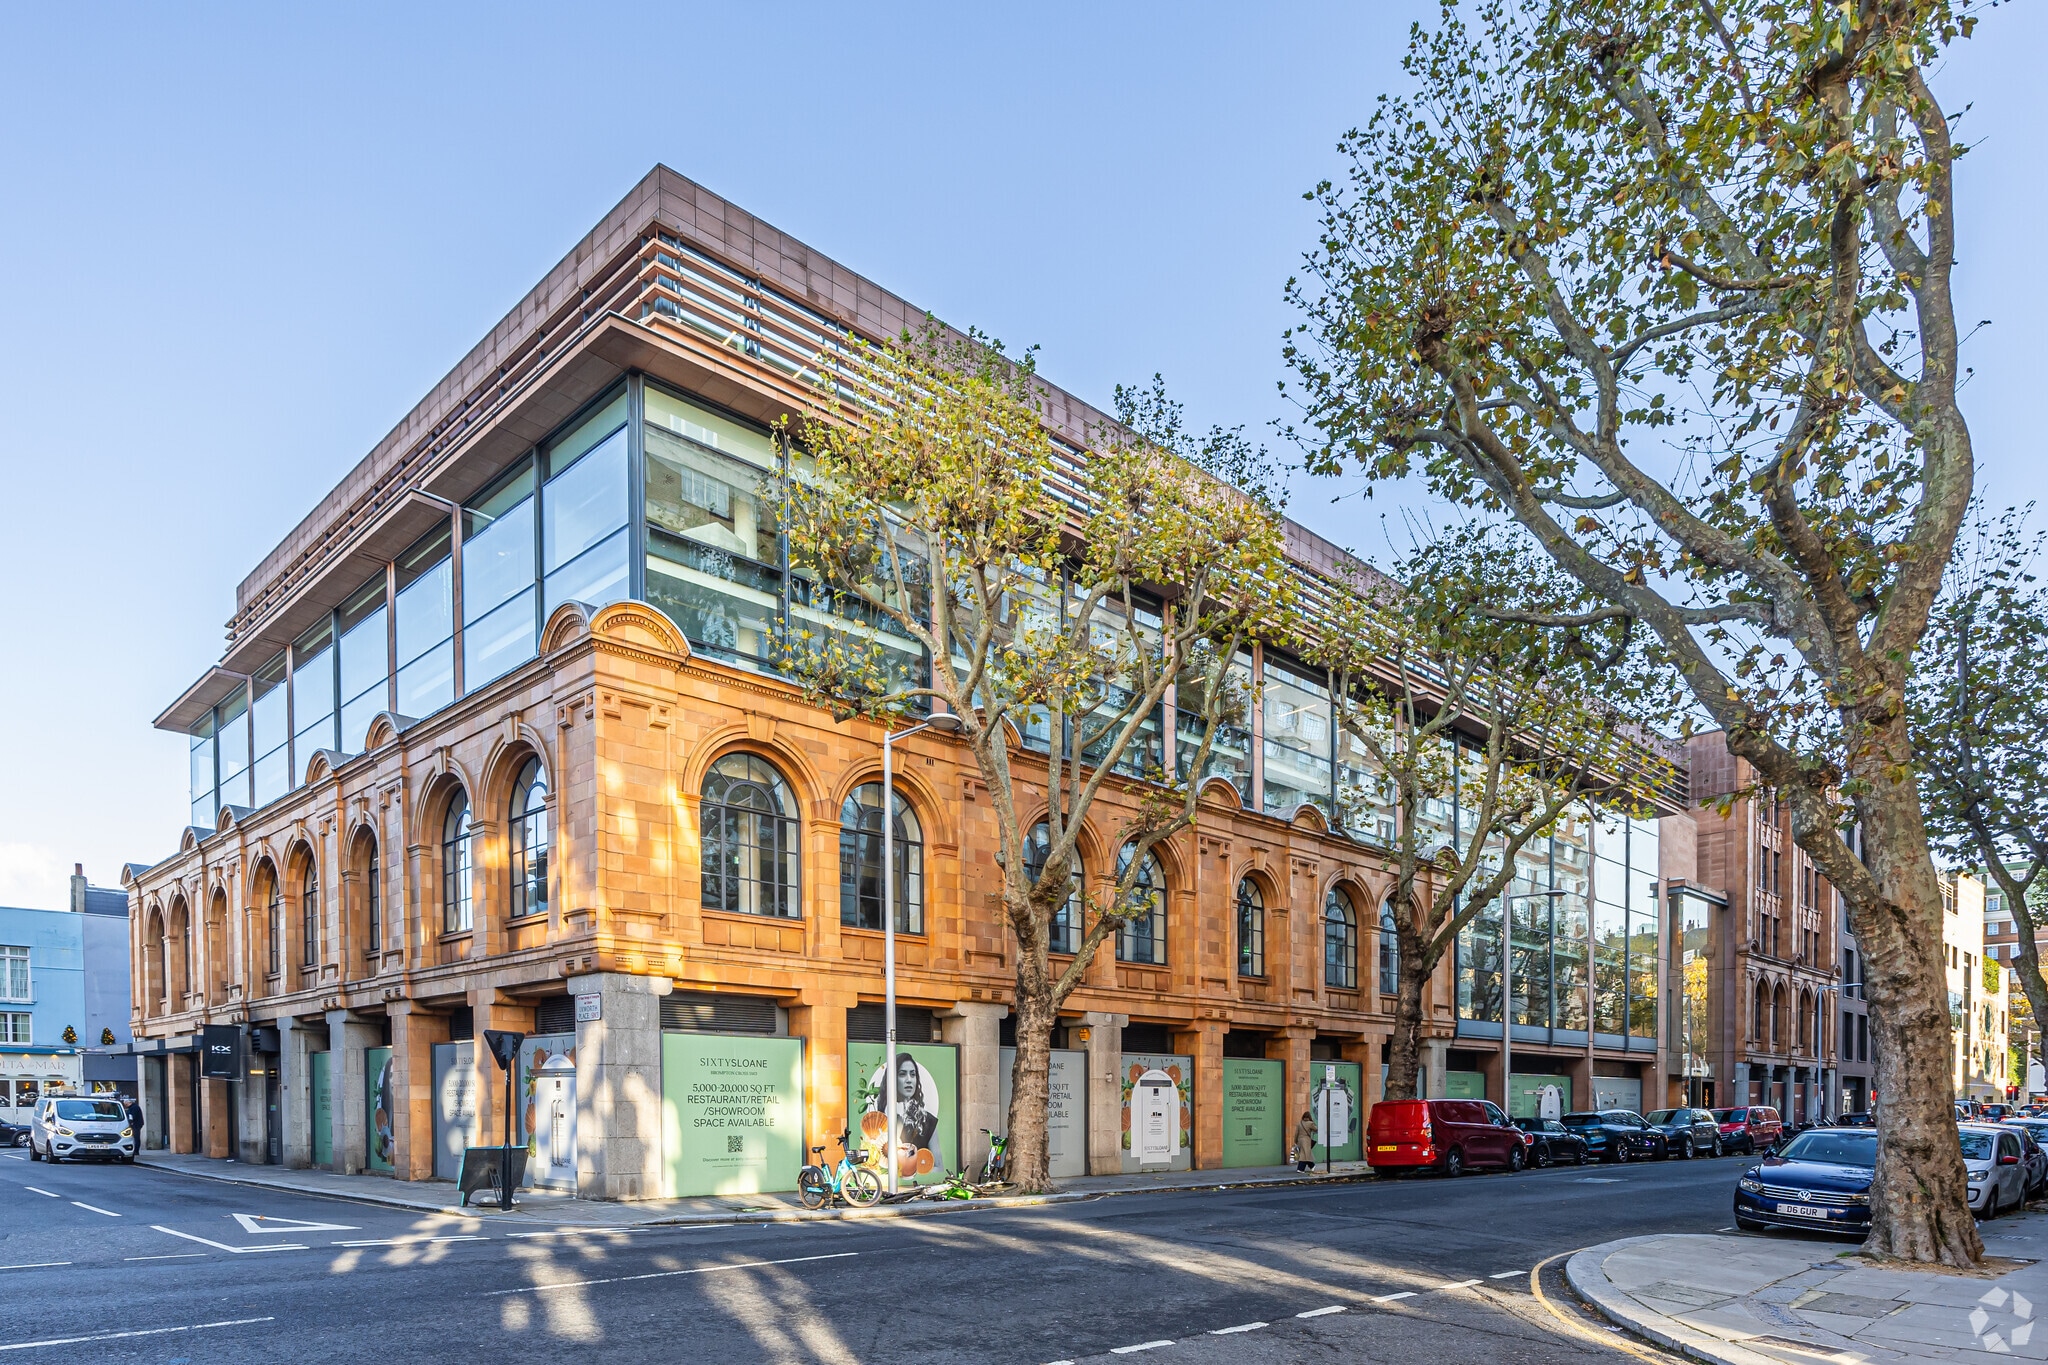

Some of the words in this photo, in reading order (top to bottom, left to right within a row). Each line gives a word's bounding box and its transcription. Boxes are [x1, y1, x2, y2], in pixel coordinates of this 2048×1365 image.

[0, 1060, 24, 1069] LTA
[35, 1061, 66, 1069] MAR
[451, 1057, 475, 1065] SIXTYSLOA
[700, 1057, 768, 1068] SIXTYSLOANE
[692, 1083, 749, 1093] 5,000-20,000
[750, 1084, 762, 1094] SQ
[764, 1084, 775, 1092] FT
[1052, 1083, 1060, 1091] SQ
[1061, 1083, 1069, 1091] FT
[687, 1095, 780, 1104] RESTAURANT/RETAIL
[704, 1106, 766, 1115] /SHOWROOM
[694, 1118, 725, 1127] SPACE
[727, 1118, 775, 1127] AVAILABLE
[1786, 1205, 1798, 1213] D6
[1800, 1207, 1818, 1216] GUR
